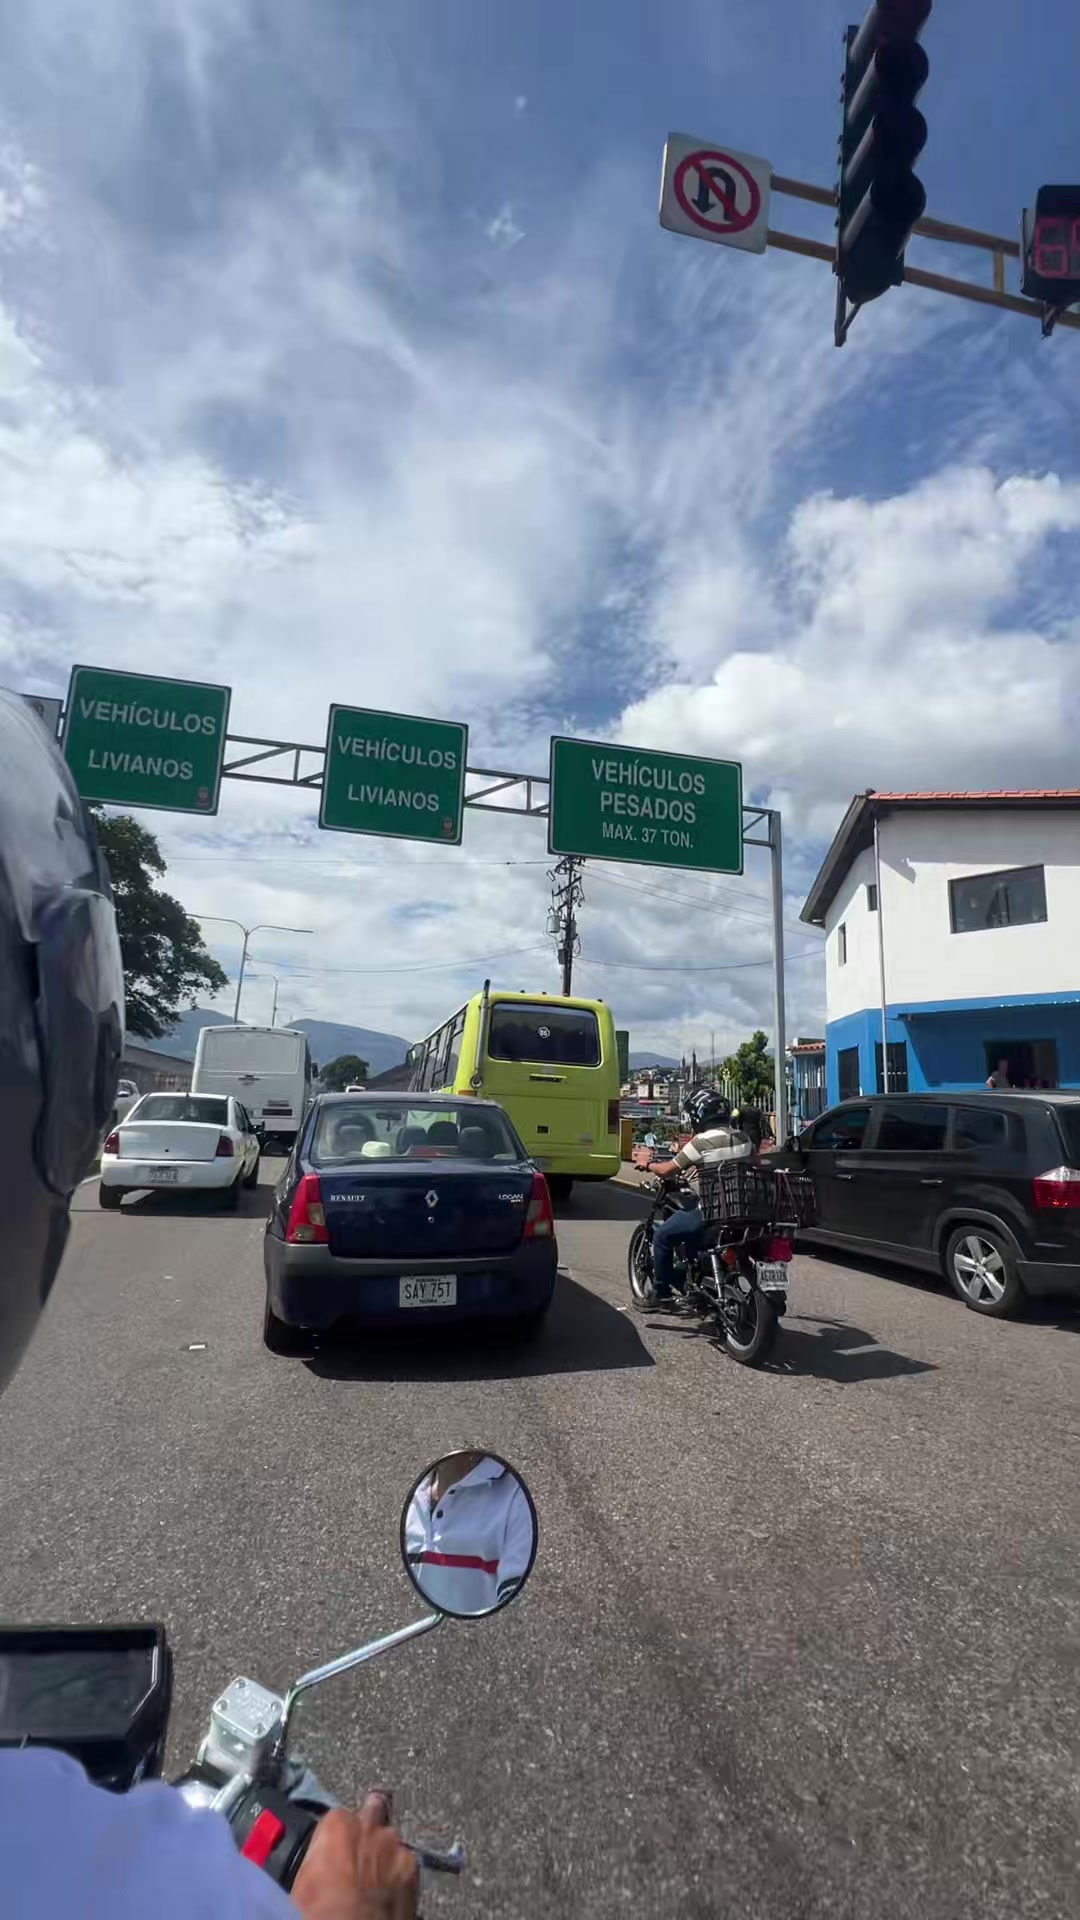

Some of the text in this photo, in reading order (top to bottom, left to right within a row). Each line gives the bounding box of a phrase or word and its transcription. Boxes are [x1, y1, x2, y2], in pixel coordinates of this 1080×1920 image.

[79, 698, 217, 735] VEHÍCULOS
[88, 749, 193, 780] LIVIANOS
[338, 735, 457, 769] VEHÍCULOS
[592, 759, 705, 795] VEHÍCULOS
[347, 784, 439, 811] LIVIANOS
[600, 791, 696, 824] PESADOS
[602, 822, 694, 848] MAX. 37 TON.
[404, 1282, 426, 1299] SAY
